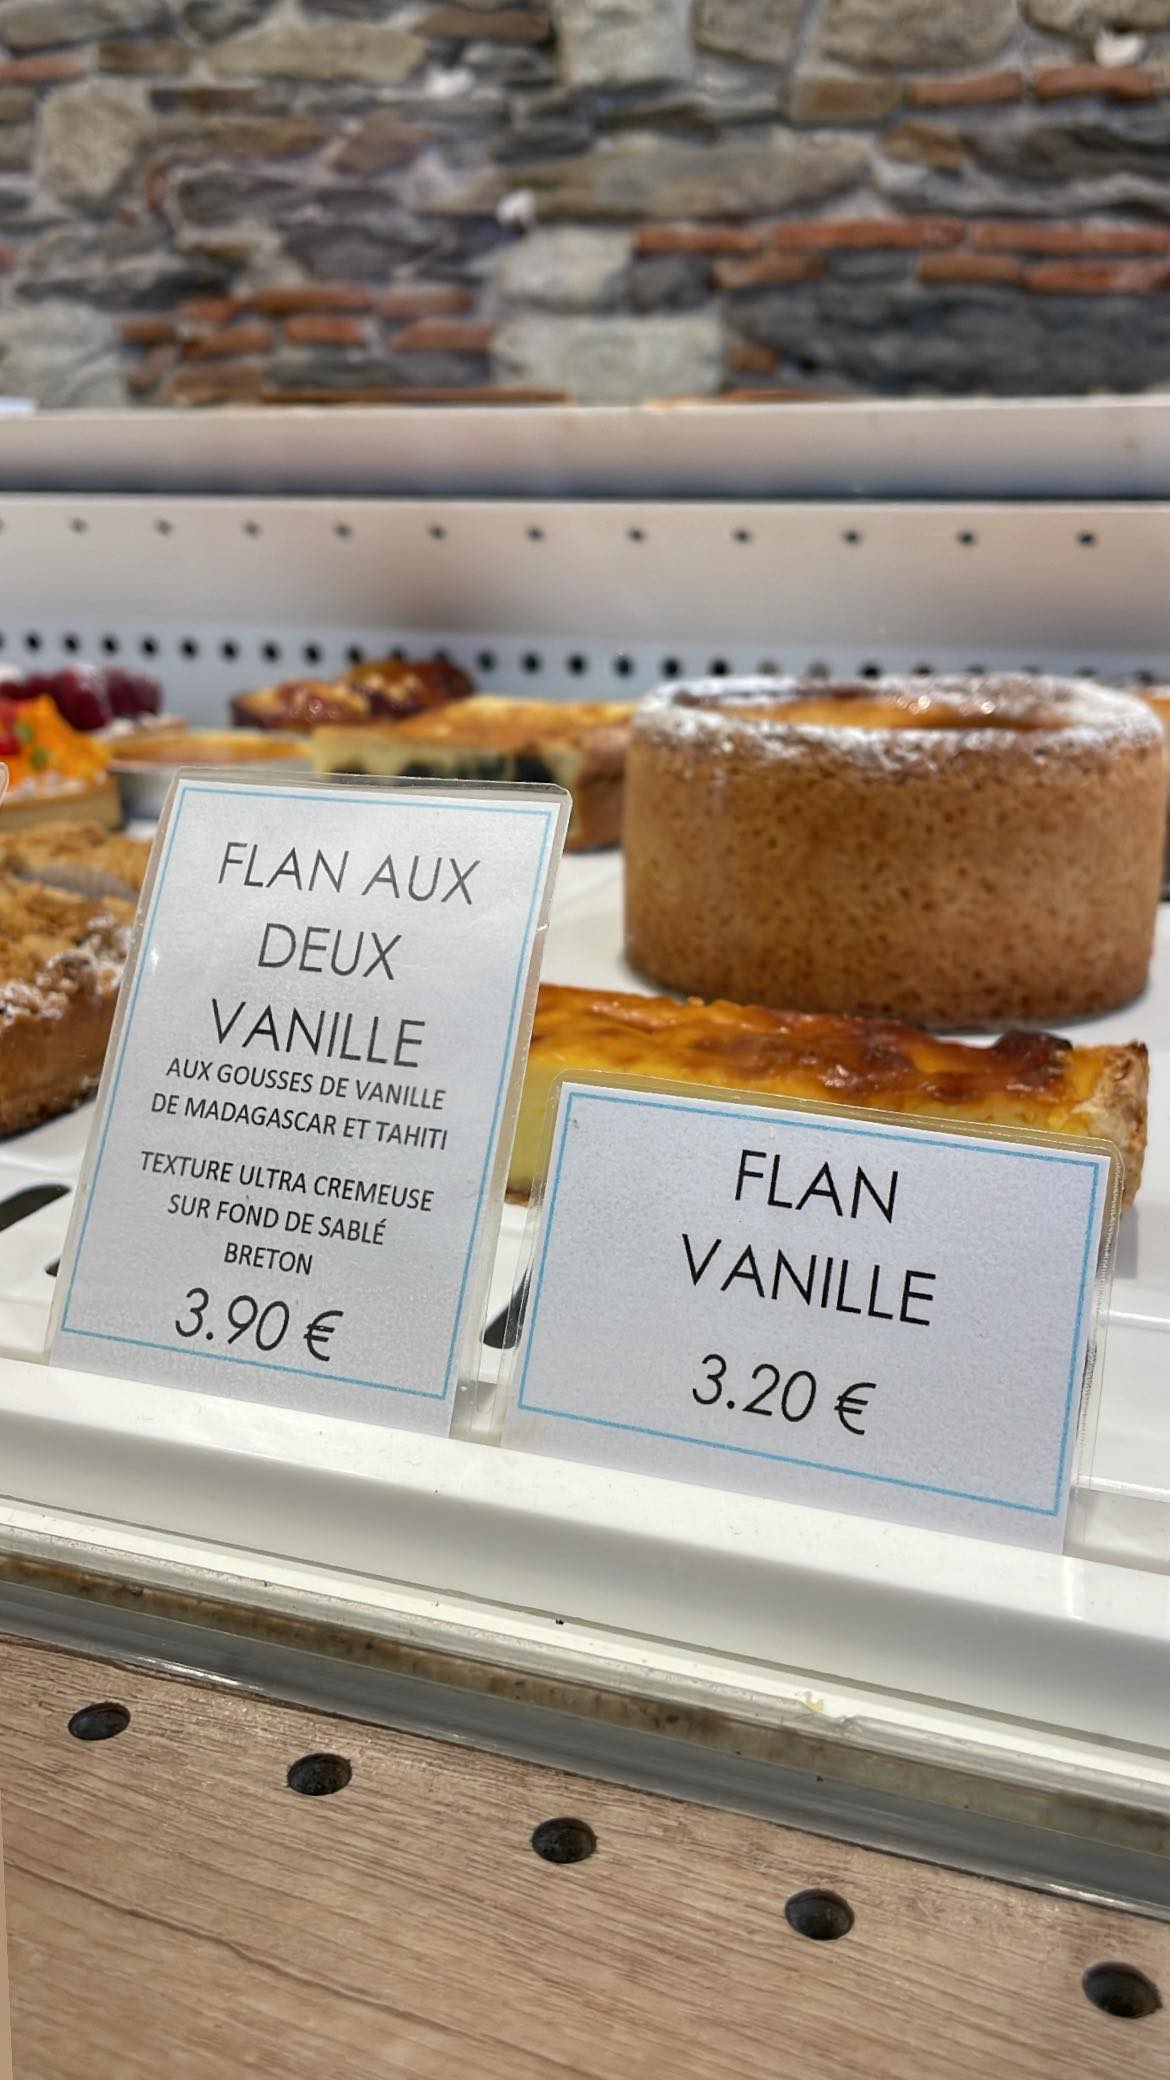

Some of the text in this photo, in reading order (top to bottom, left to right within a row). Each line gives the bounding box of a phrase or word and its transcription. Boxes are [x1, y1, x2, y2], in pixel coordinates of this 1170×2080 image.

[217, 841, 481, 906] FLAN AUX
[257, 922, 403, 981] DEUX
[211, 997, 426, 1068] VANILLE
[165, 1057, 447, 1111] AUX GOUSSES DE VANILLE
[151, 1092, 448, 1151] DE MADAGASCAR ET TAHITI
[140, 1150, 435, 1212] TEXTURE ULTRA CREMEUSE
[734, 1148, 899, 1224] FLAN
[167, 1193, 387, 1246] SUR FOND DE SABLÉ
[223, 1241, 313, 1276] BRETON
[681, 1233, 937, 1327] VANILLE
[174, 1287, 345, 1363] 3.90 €
[692, 1353, 878, 1436] 3.20 €
